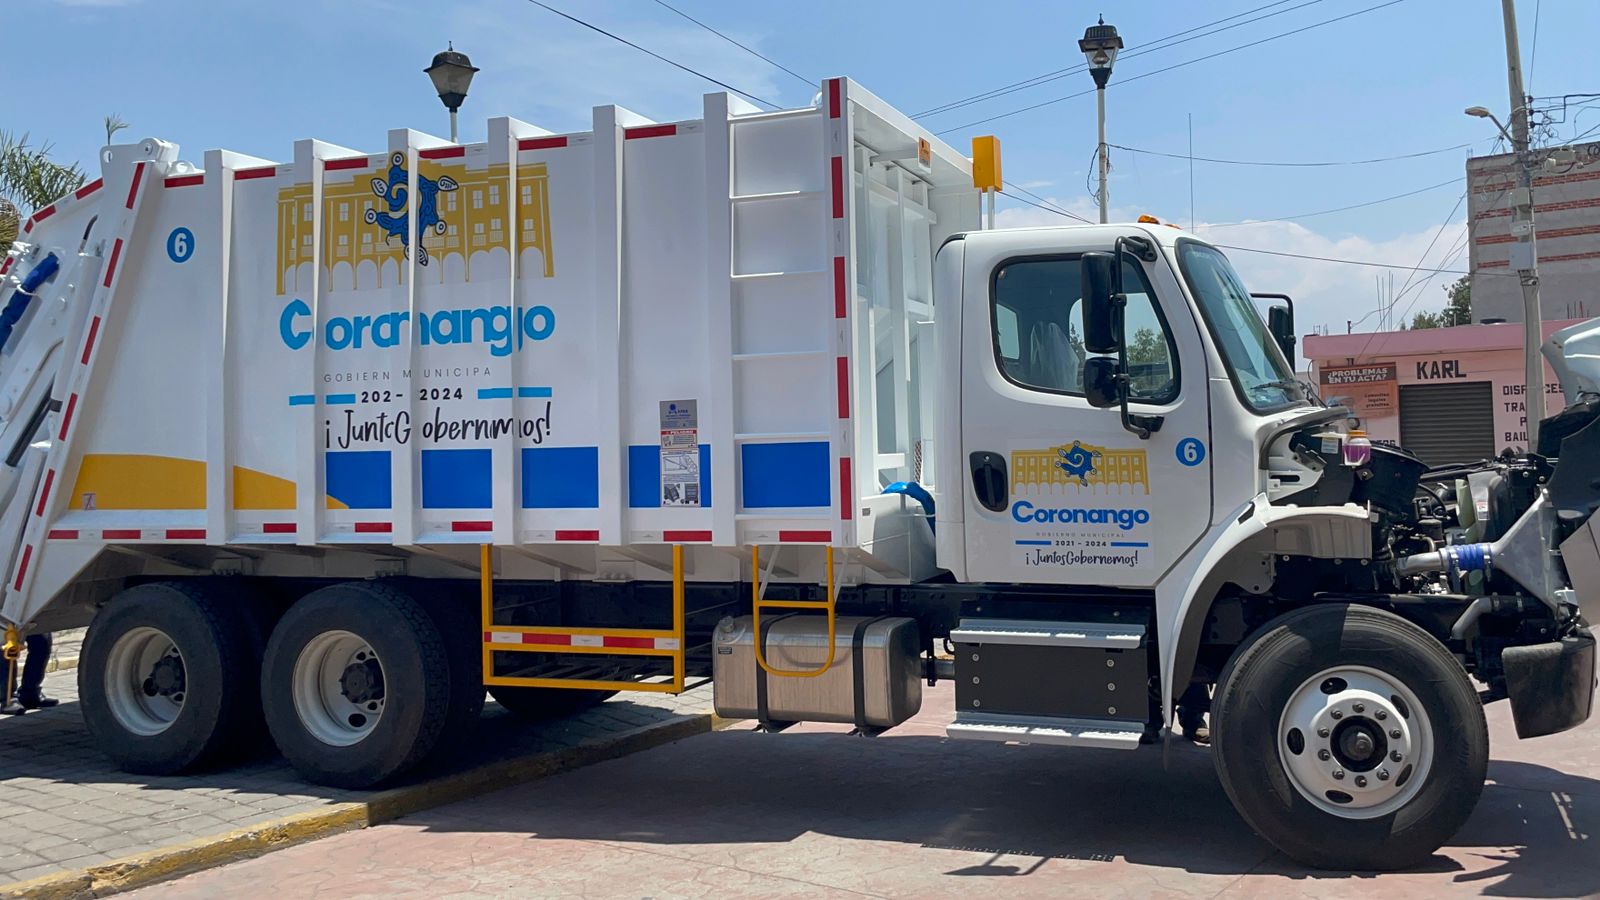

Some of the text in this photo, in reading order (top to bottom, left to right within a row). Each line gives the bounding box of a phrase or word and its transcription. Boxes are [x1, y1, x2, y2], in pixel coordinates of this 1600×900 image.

[174, 232, 188, 258] 6
[323, 367, 492, 384] GOBIERN MUNICIPA
[1327, 367, 1388, 379] ¿PROBLEMAS
[1357, 374, 1387, 382] ACTA?
[1416, 359, 1467, 380] KARL
[419, 387, 463, 401] 2024
[1183, 442, 1198, 462] 6
[1011, 500, 1150, 531] Coronango
